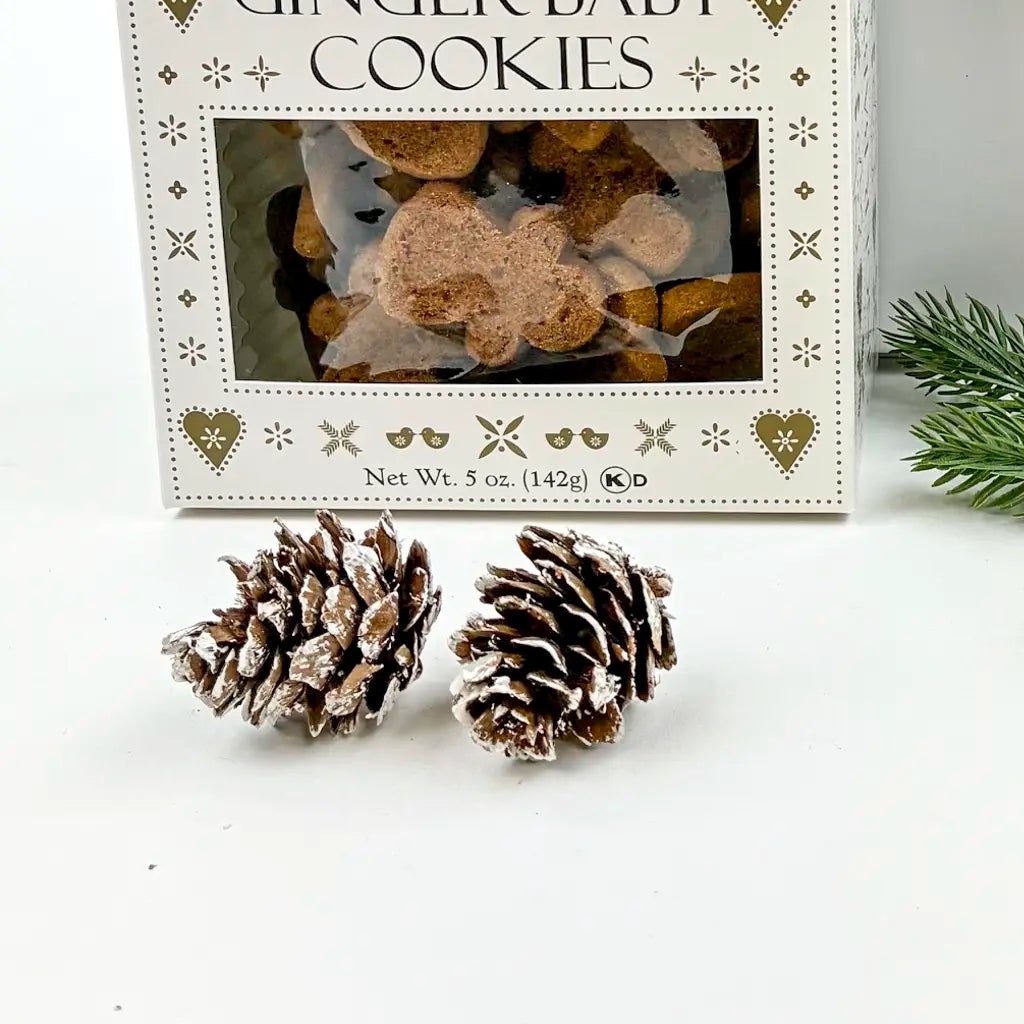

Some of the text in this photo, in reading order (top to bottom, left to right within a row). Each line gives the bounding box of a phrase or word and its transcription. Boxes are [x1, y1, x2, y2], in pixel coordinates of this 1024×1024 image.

[310, 35, 654, 91] COOKIES
[363, 467, 408, 486] Net
[415, 467, 457, 487] Wt.
[465, 468, 477, 487] 5
[485, 472, 515, 487] oz.
[522, 468, 588, 493] (142g)
